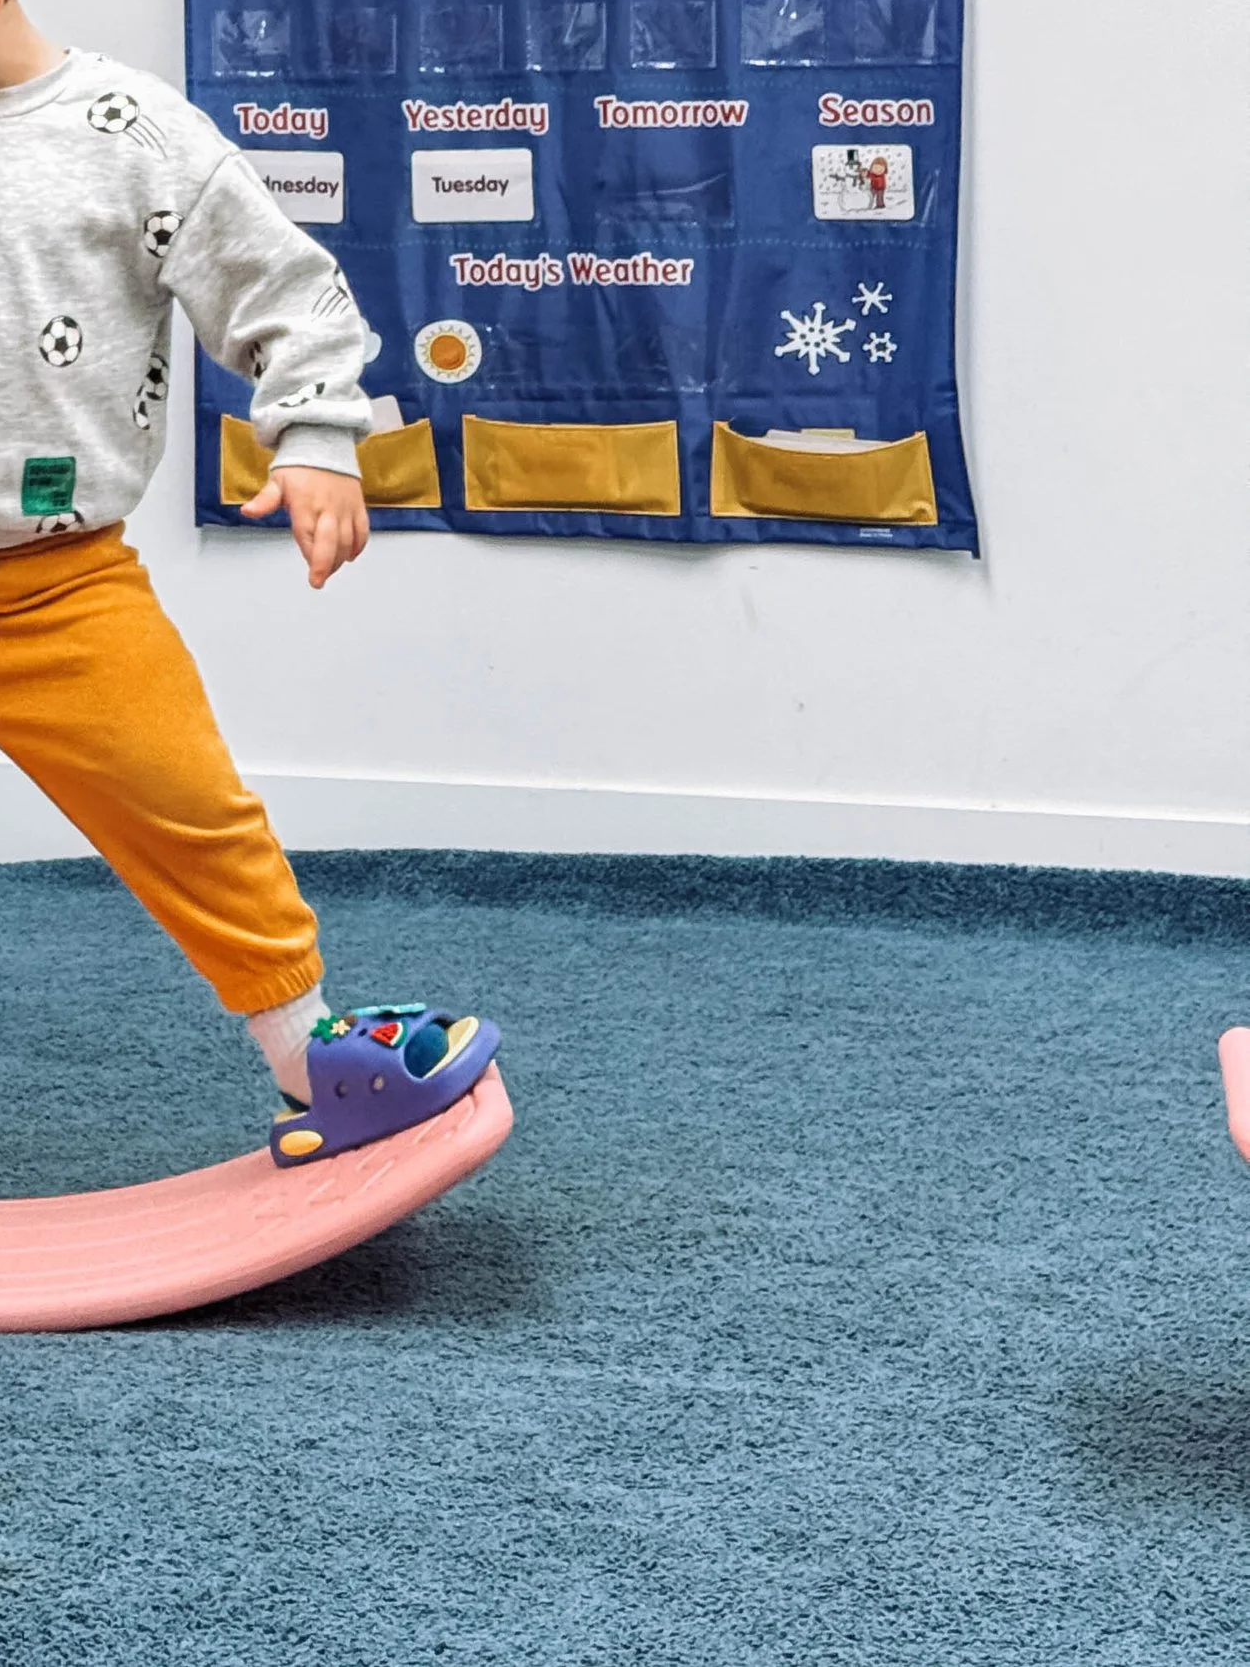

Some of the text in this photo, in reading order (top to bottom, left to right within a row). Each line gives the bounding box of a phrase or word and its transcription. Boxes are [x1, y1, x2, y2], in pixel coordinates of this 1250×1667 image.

[236, 104, 326, 137] Today
[404, 99, 548, 133] Yesterday
[597, 97, 746, 126] Tomorrow
[820, 96, 933, 124] Season
[431, 176, 509, 196] Tuesday
[453, 254, 693, 288] Today's Weather
